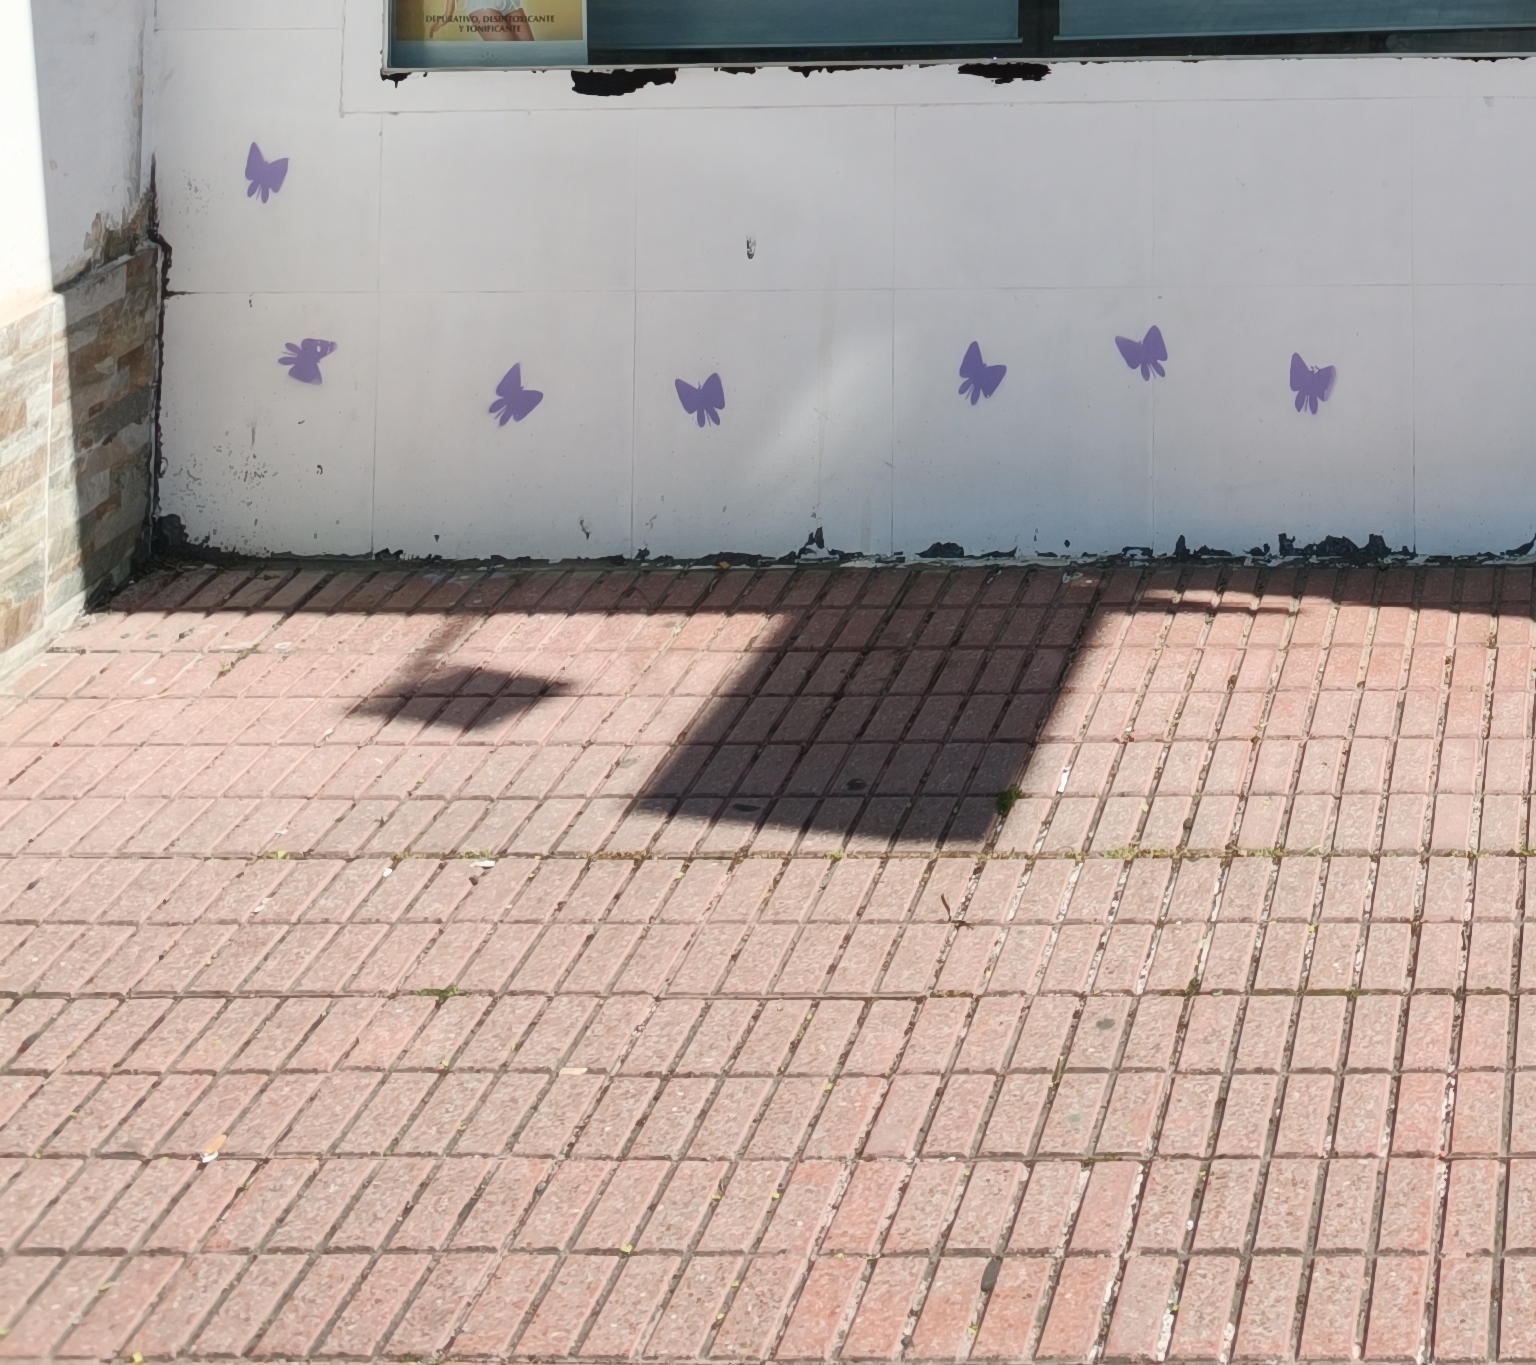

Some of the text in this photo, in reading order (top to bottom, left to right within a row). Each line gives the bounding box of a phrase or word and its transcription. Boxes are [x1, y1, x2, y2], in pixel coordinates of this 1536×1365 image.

[425, 14, 556, 23] DEPURATIVO, DESINTOXICANTE
[465, 24, 522, 33] TONIFICANTE
